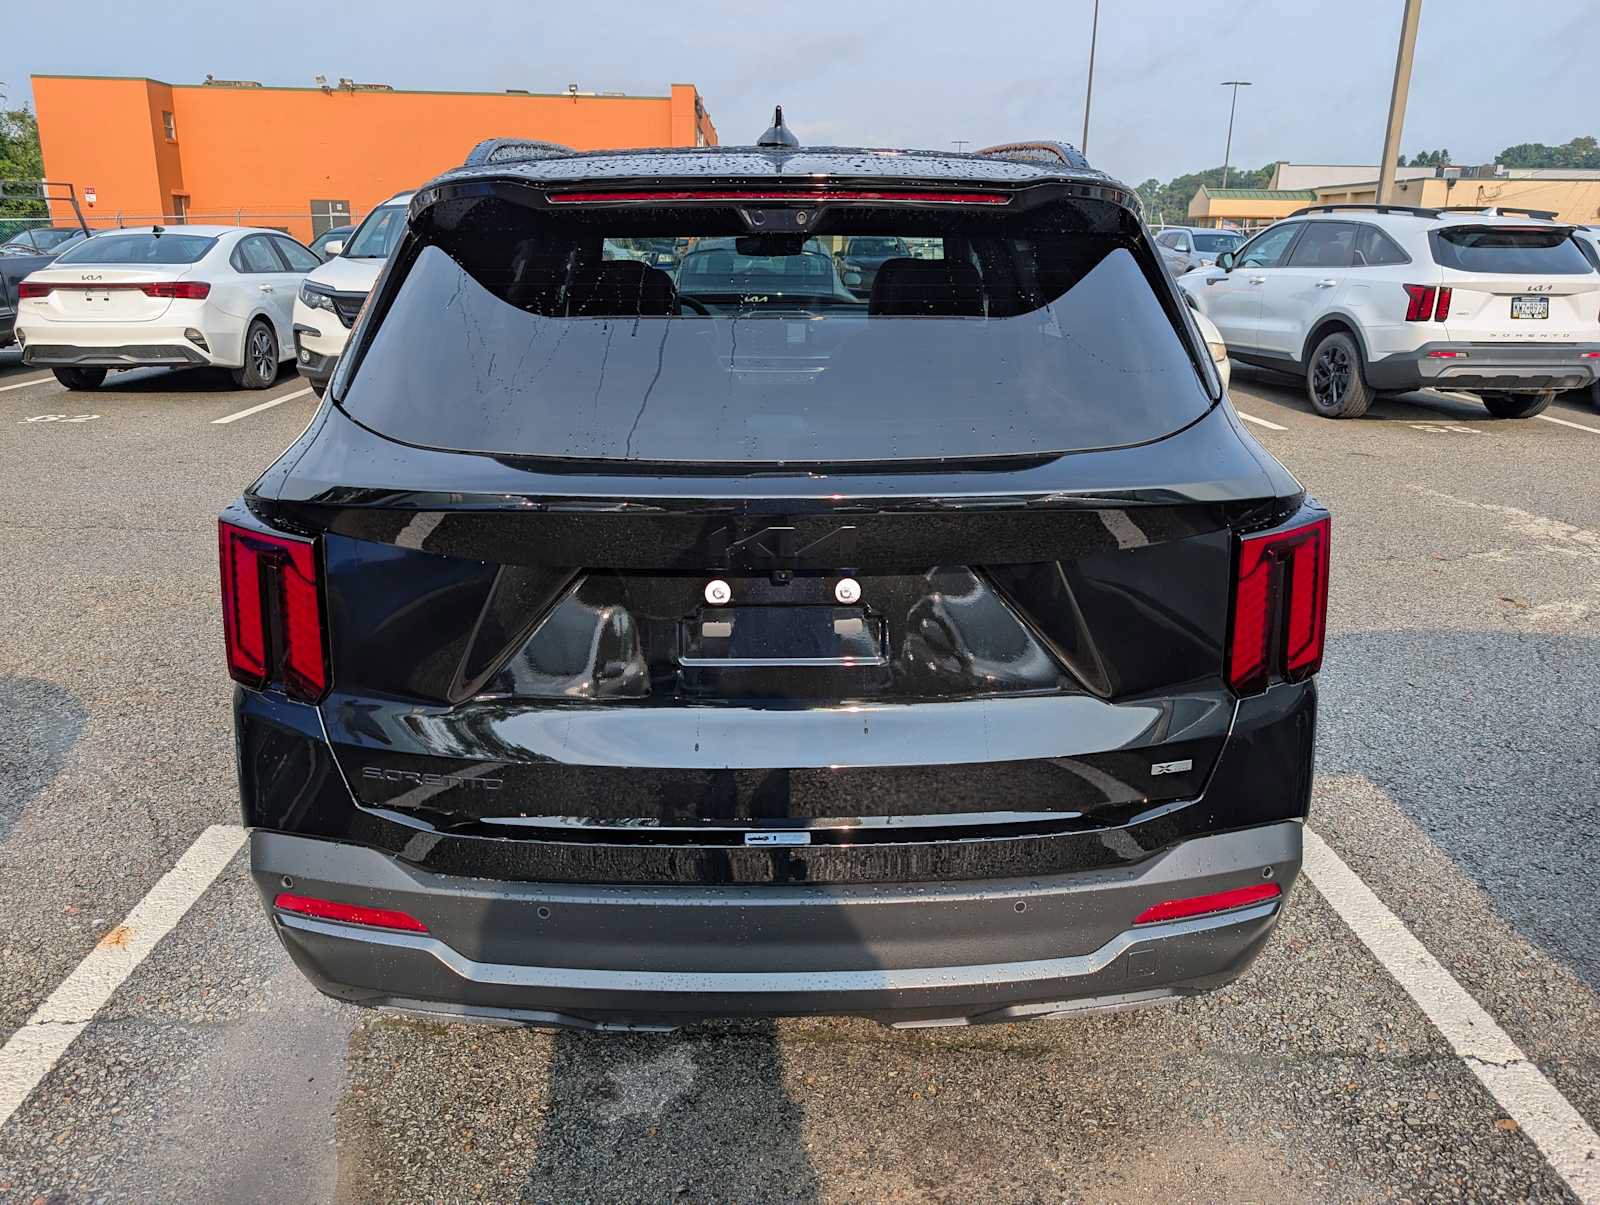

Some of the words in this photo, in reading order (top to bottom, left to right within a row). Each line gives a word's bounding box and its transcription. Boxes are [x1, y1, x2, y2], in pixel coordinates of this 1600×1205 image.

[744, 295, 769, 303] KIA
[705, 526, 860, 570] KIA
[362, 767, 503, 790] SORENTO
